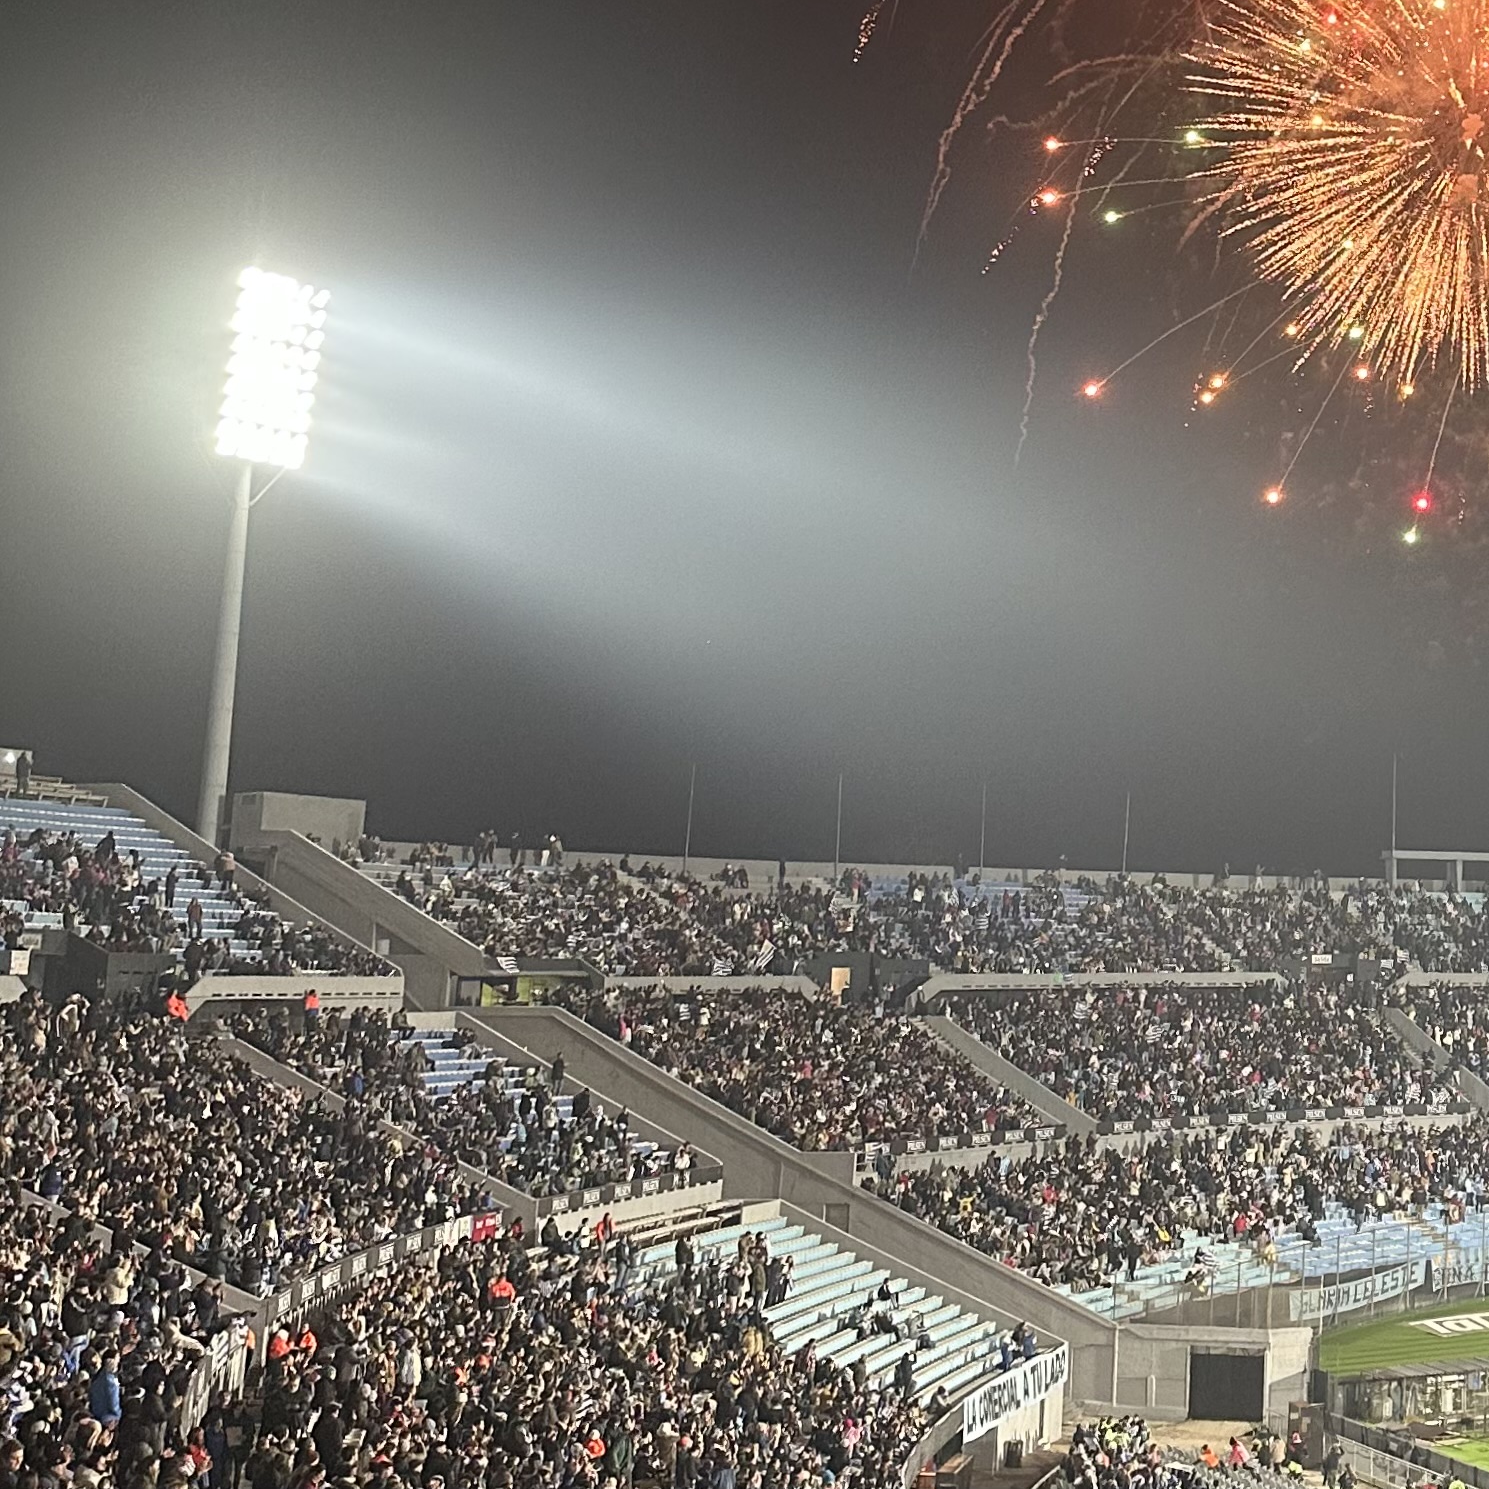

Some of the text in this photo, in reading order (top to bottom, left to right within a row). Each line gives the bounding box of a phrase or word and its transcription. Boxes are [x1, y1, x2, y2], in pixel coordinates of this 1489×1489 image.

[967, 1349, 1066, 1435] LA COMERCIAL A TU LADO
